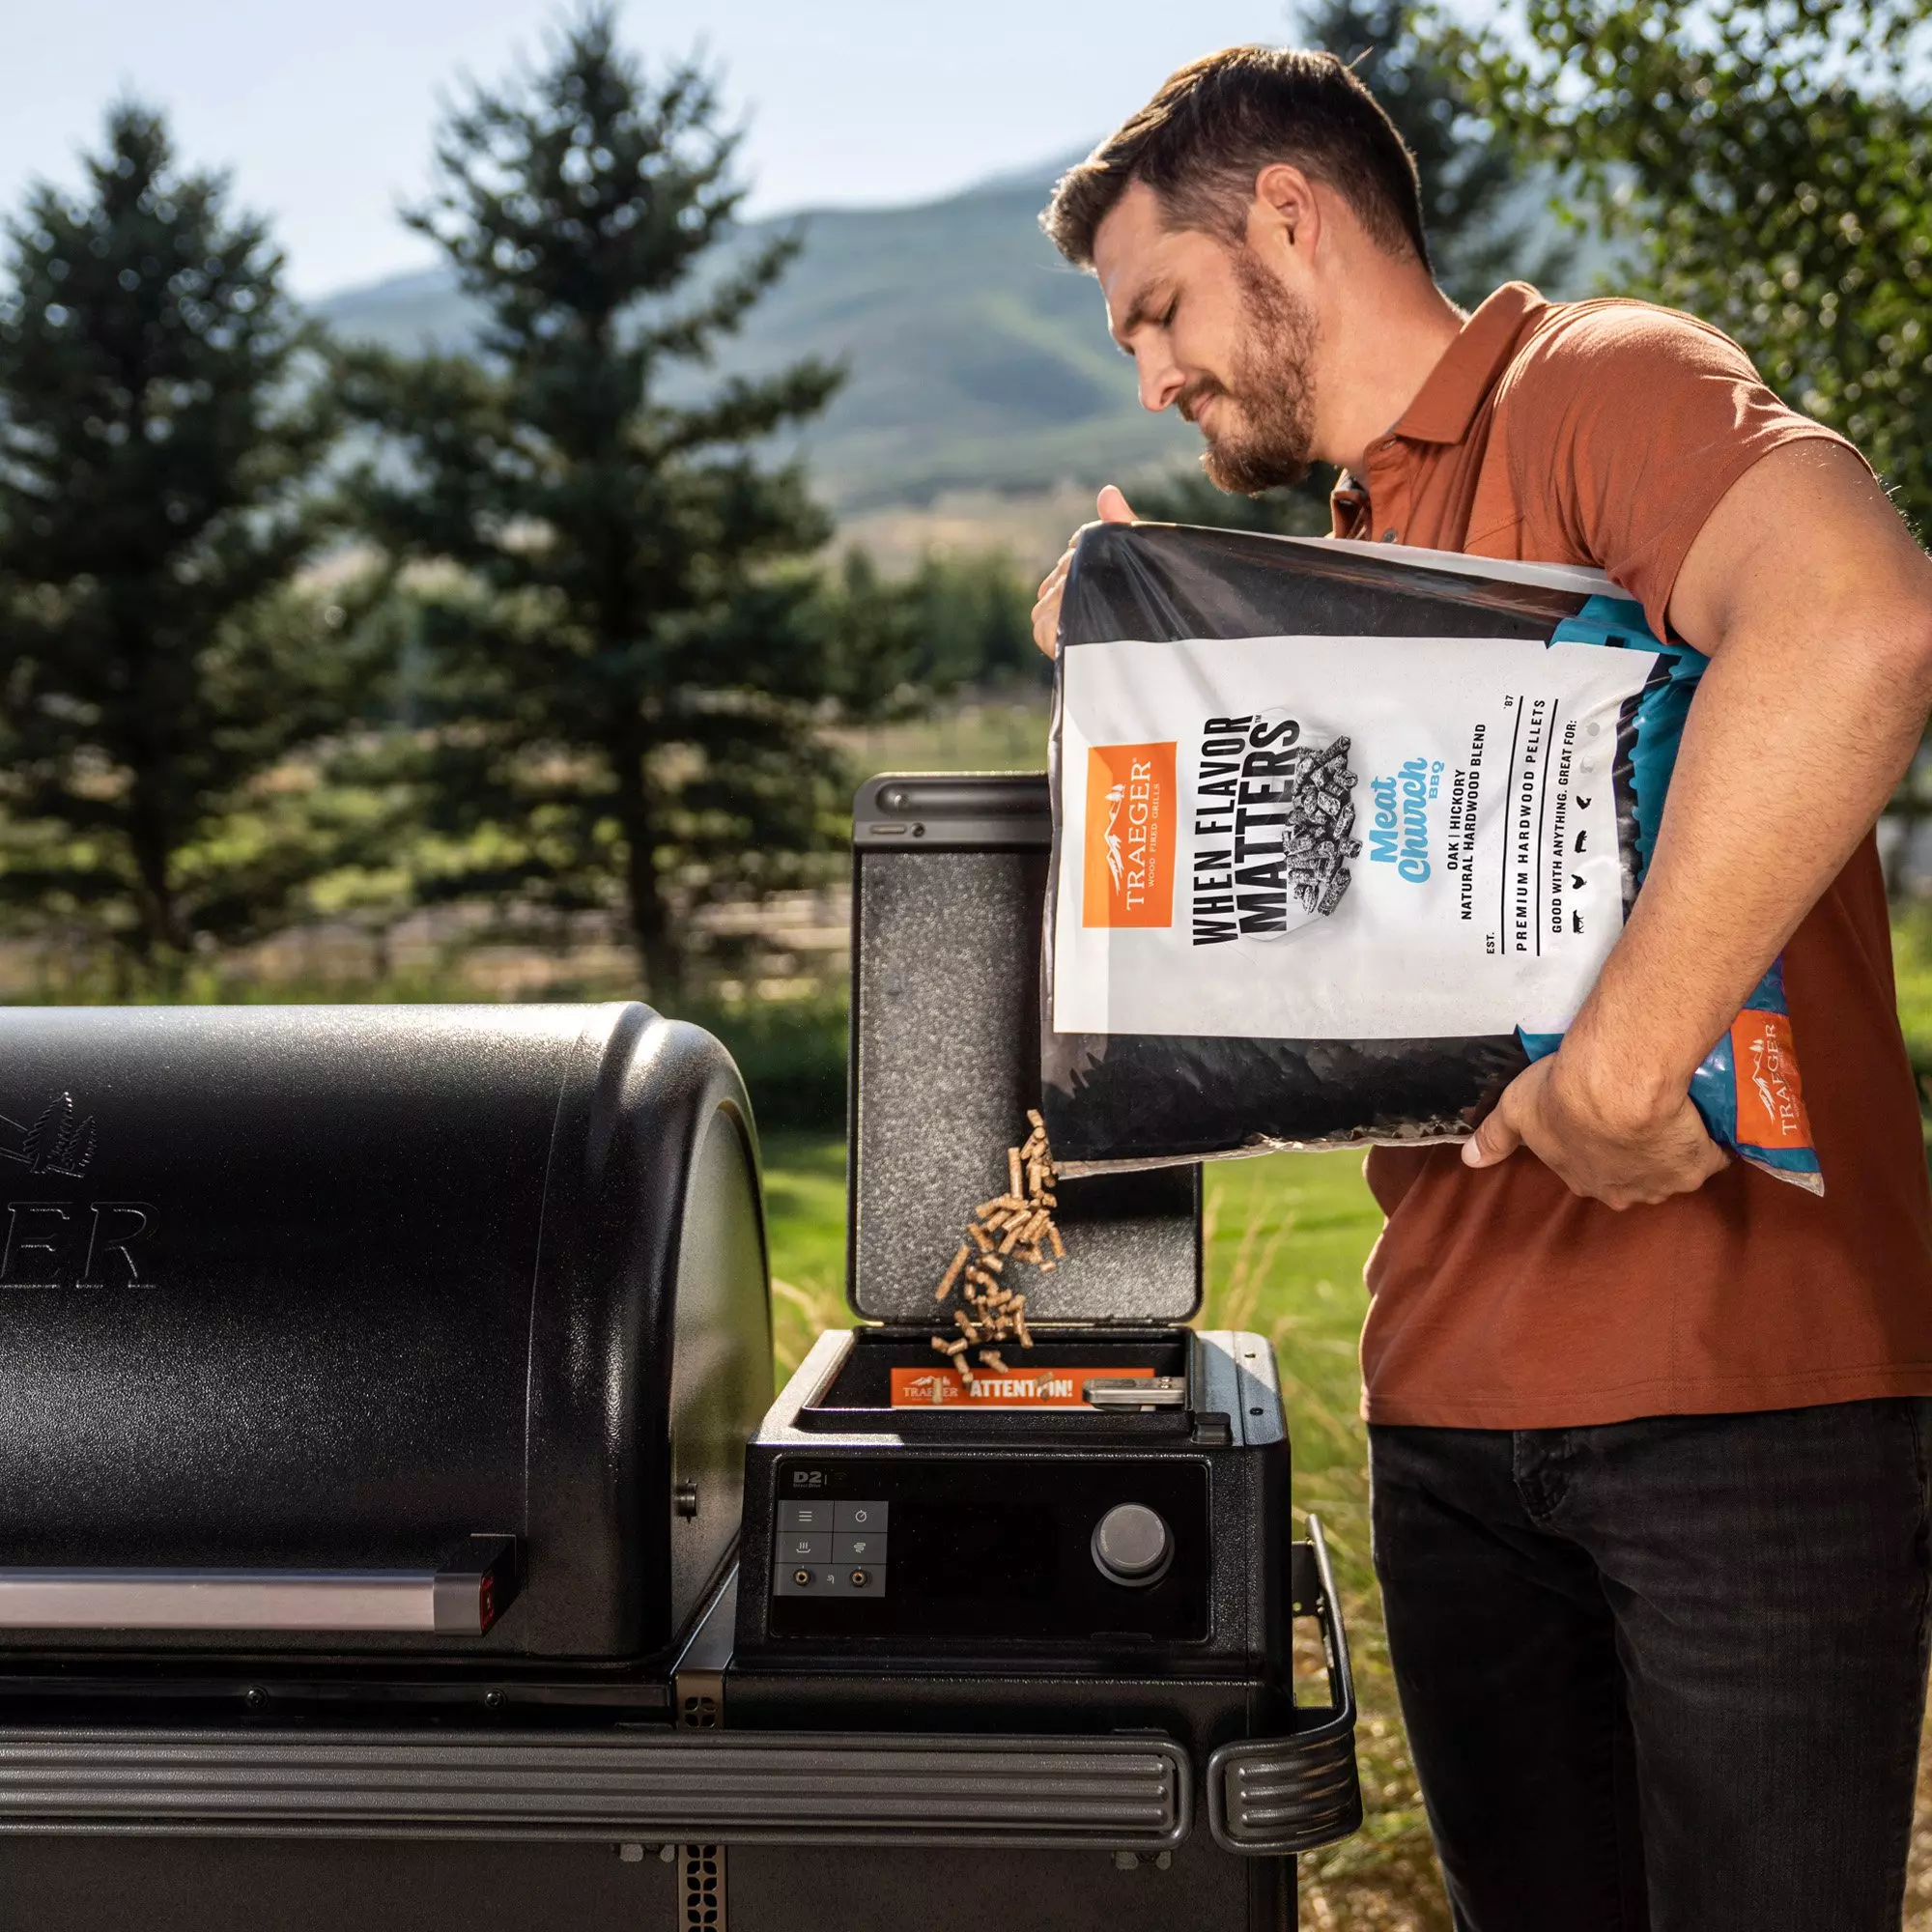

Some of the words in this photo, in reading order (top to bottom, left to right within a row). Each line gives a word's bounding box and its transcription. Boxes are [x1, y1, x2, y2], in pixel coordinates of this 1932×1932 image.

[1470, 724, 1487, 767] BLEND
[1524, 699, 1547, 763] PELLETS
[1564, 720, 1577, 746] FOR:
[1194, 715, 1254, 836] FLAVOR
[1428, 760, 1445, 800] BBQ
[1557, 734, 1573, 785] GREAT
[1151, 783, 1160, 818] GRILLS
[1368, 776, 1399, 864] Meat
[1397, 757, 1432, 884] Church
[1449, 769, 1466, 830] HICKORY
[1463, 771, 1480, 851] HARDWOOD
[1518, 771, 1535, 864] HARDWOOD
[1552, 789, 1568, 857] ANYTHING.
[1150, 822, 1158, 852] FIRED
[1447, 841, 1460, 870] OAK
[1148, 857, 1156, 888] WOOD
[1461, 855, 1474, 921] NATURAL
[1551, 860, 1563, 895] WITH
[1192, 850, 1239, 946] WHEN
[1516, 872, 1528, 952] PREMIUM
[1551, 897, 1563, 934] GOOD
[1486, 931, 1495, 954] EST.
[902, 1387, 959, 1397] TRAEER
[793, 1470, 822, 1484] D2
